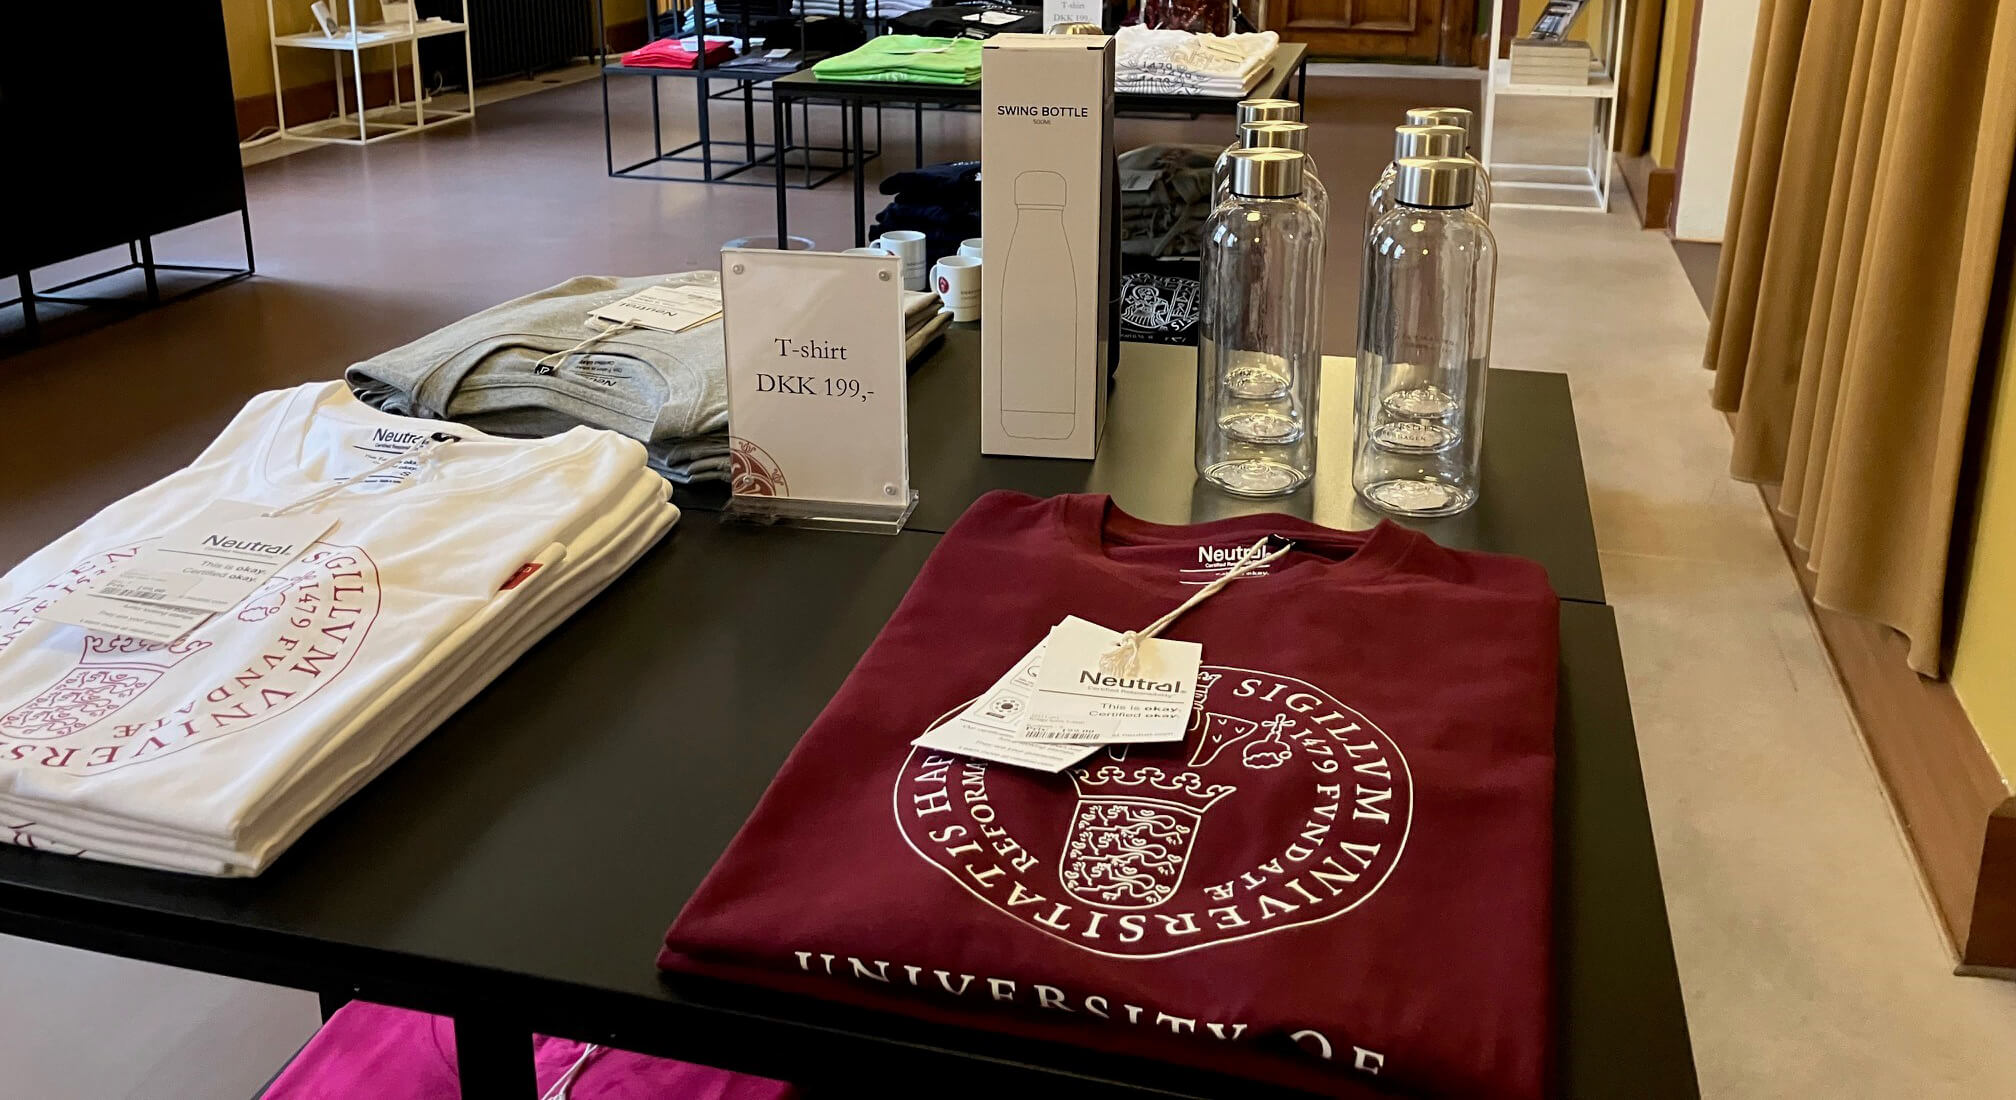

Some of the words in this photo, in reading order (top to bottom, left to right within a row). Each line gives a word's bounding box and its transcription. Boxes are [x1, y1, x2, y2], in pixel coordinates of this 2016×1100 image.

[997, 105, 1039, 117] SWING
[1041, 106, 1089, 118] BOTTLE
[774, 338, 848, 360] T-shirt
[755, 373, 817, 396] DKK
[824, 377, 875, 403] 199,-
[1088, 711, 1142, 719] Certified
[1101, 703, 1127, 711] This
[1233, 679, 1393, 825] SIGILLVM
[1290, 728, 1340, 774] 1479
[928, 825, 1382, 943] VNIVERSITATIS
